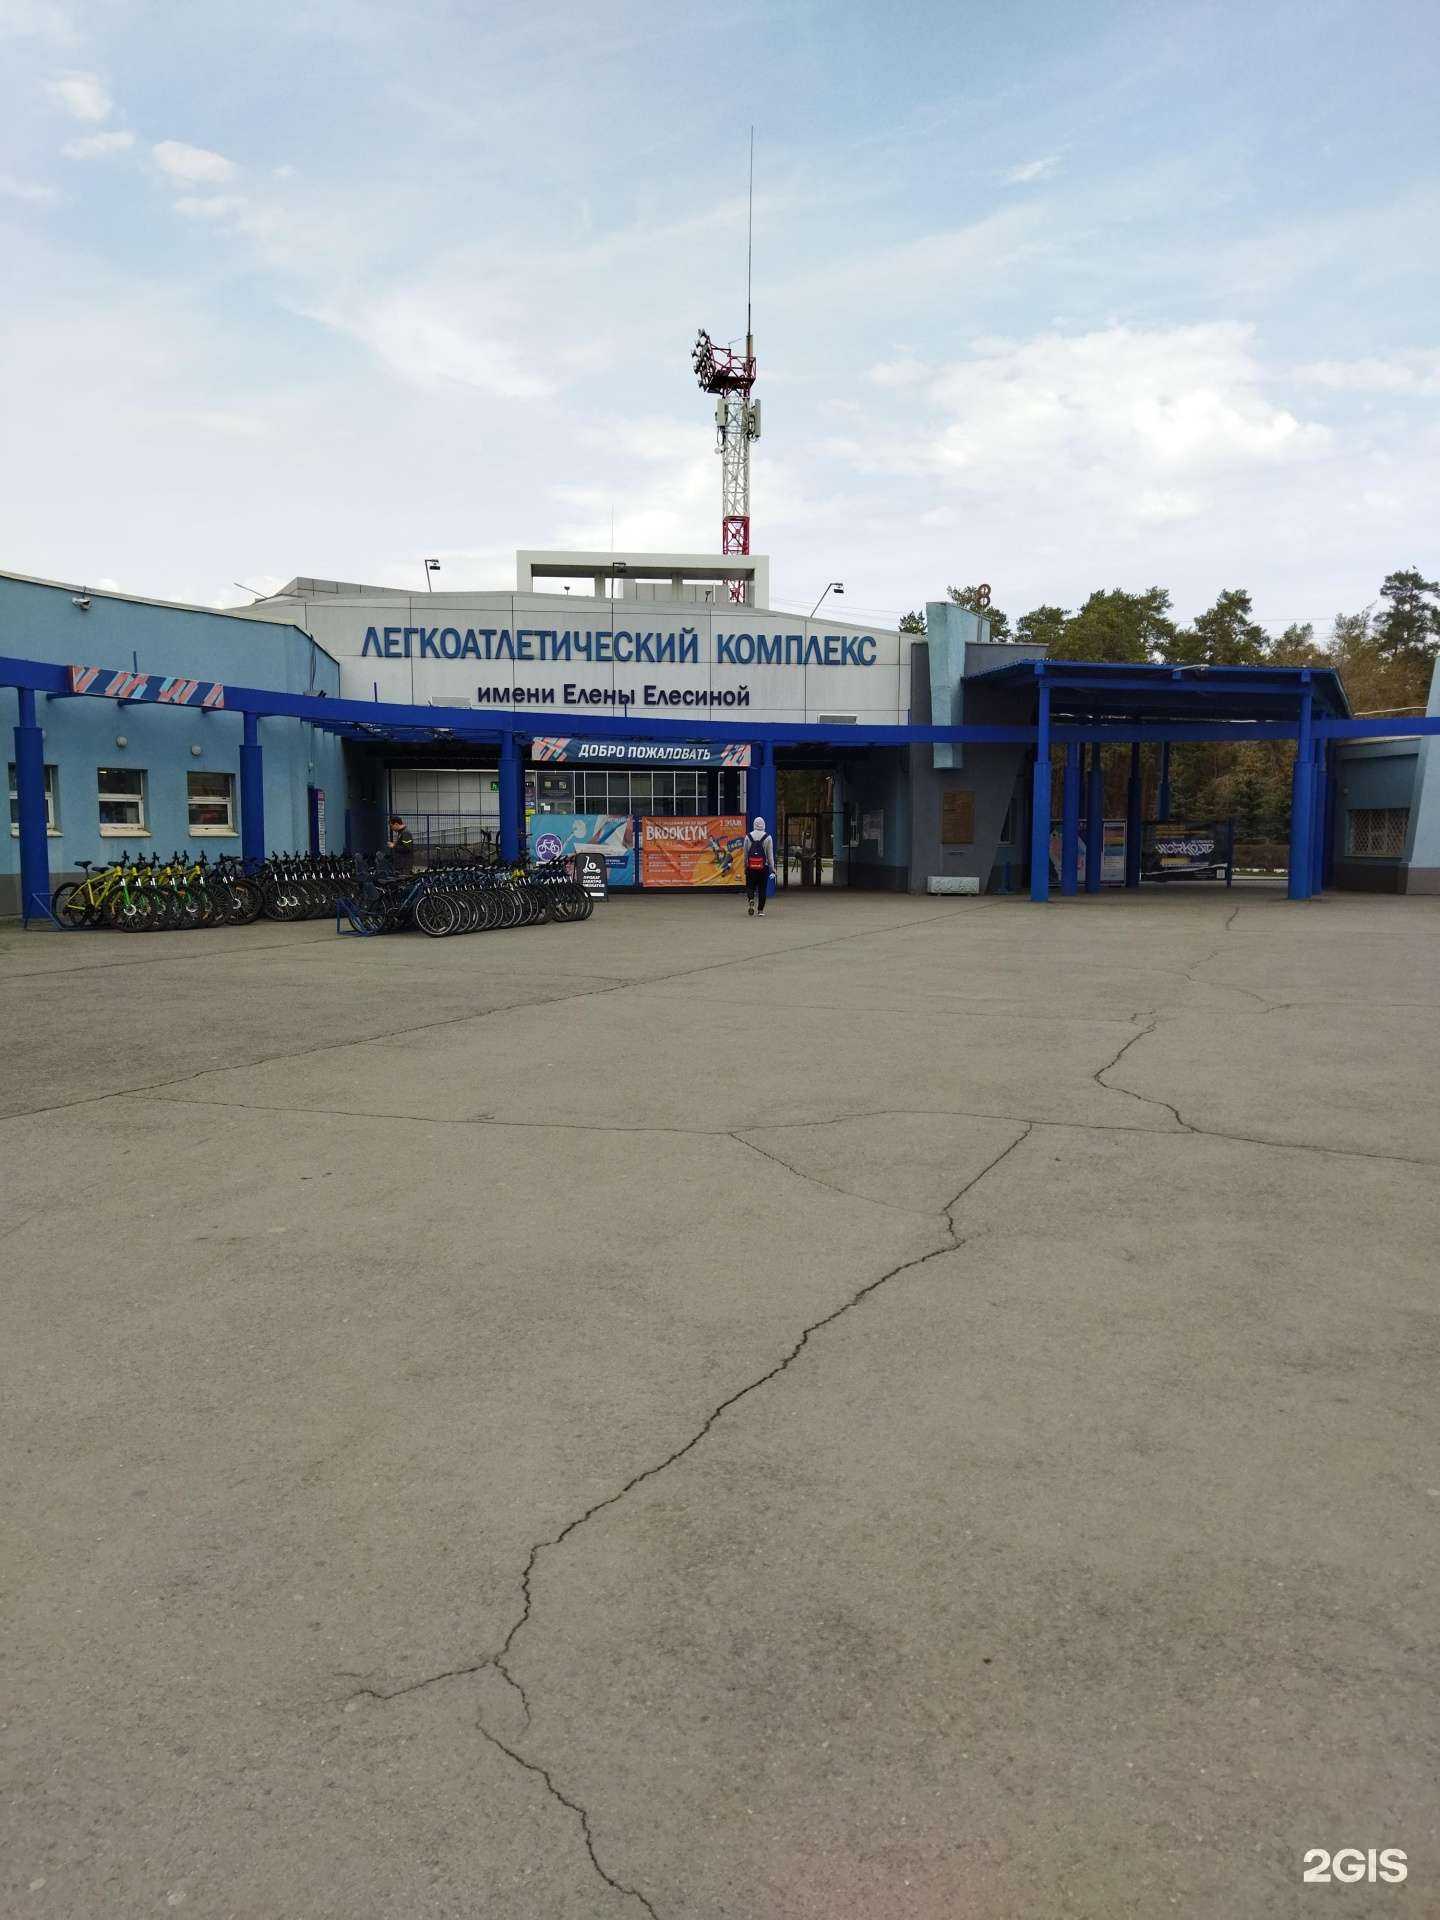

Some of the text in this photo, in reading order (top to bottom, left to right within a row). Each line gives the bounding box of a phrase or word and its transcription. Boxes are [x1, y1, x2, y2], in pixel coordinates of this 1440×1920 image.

[361, 626, 877, 666] ЛЕГКОАТЛЕТИЧЕСКИЙ КОМПЛЕКС
[477, 683, 750, 706] имени Елены Елесиной
[578, 744, 711, 760] ДОБРО ПОЖАЛОВАТЬ
[646, 825, 708, 841] BROOKLYN
